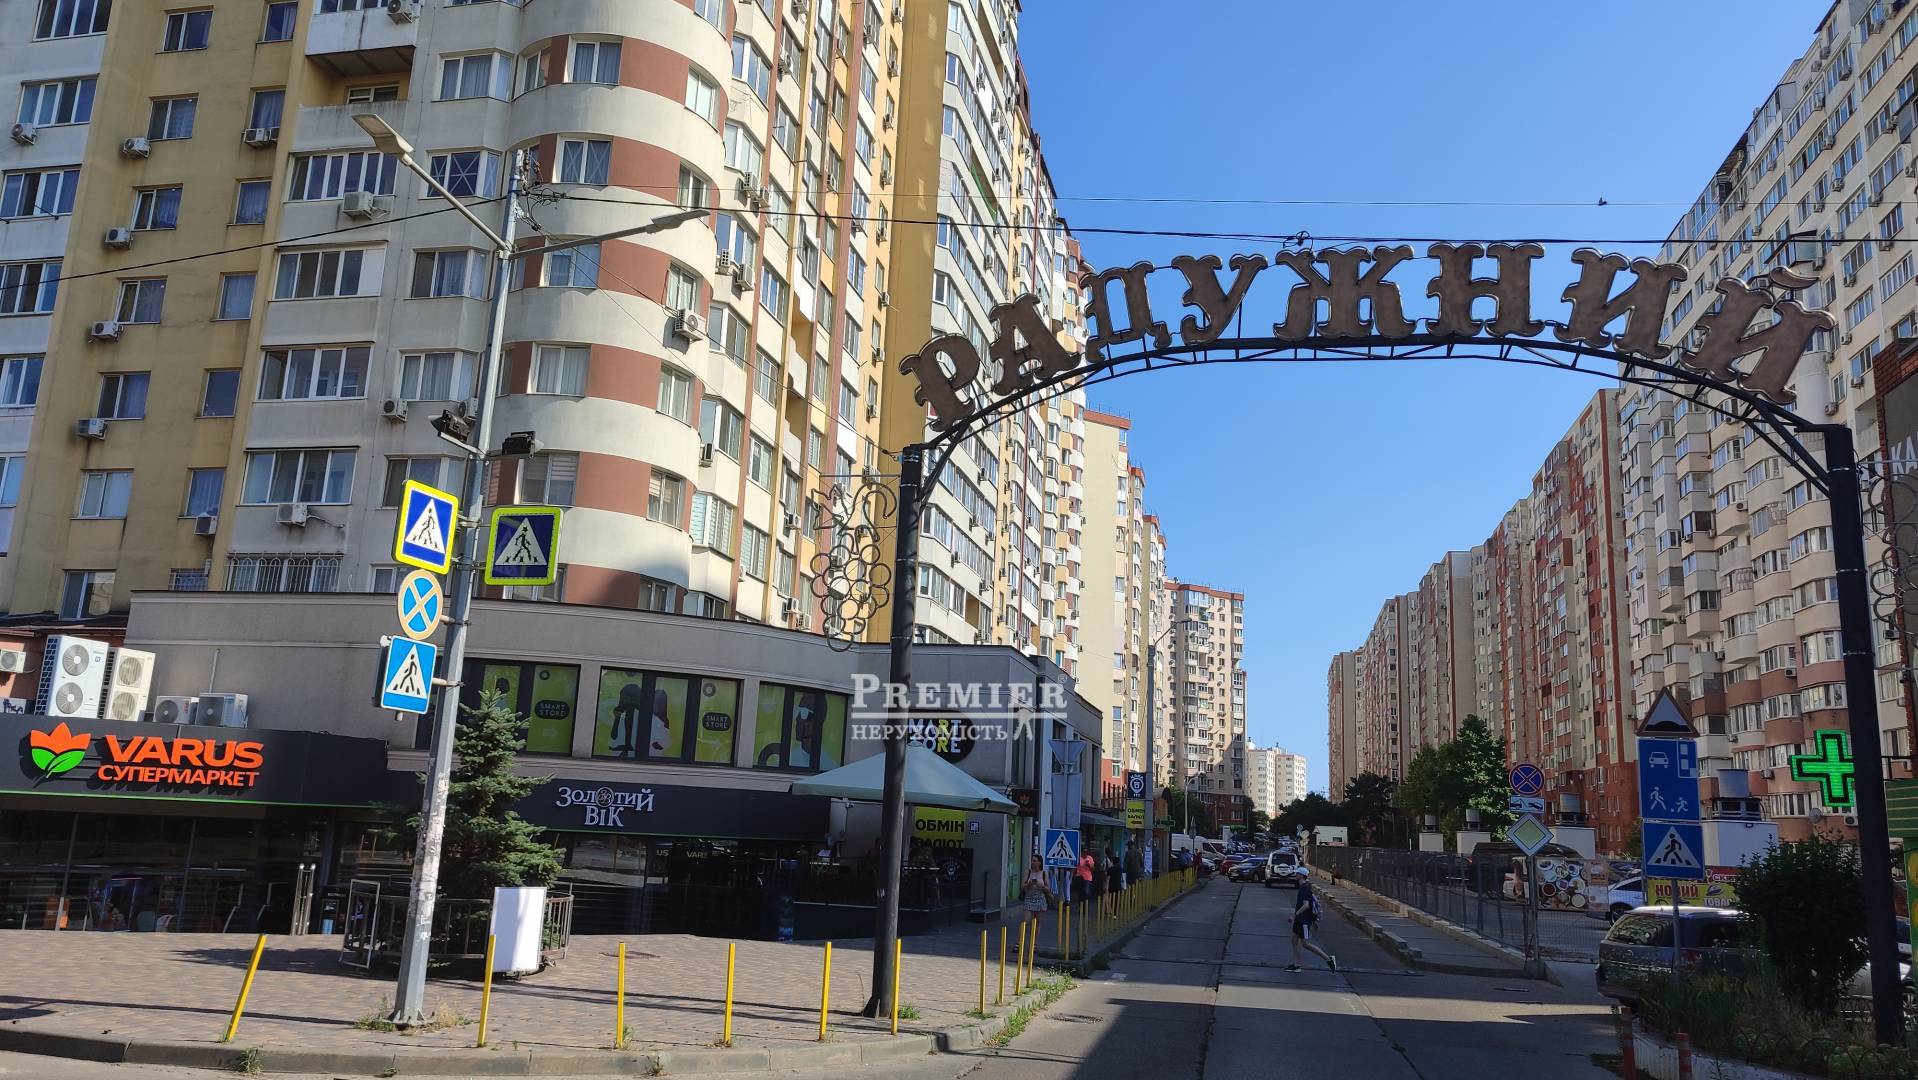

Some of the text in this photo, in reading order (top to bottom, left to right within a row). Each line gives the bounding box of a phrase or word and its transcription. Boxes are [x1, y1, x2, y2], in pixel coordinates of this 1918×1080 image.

[899, 241, 1834, 432] РАДУЖНИЙ
[105, 734, 264, 769] VARUS
[98, 764, 260, 787] СУПЕРМАРКЕТ
[915, 818, 965, 833] ОБМІН
